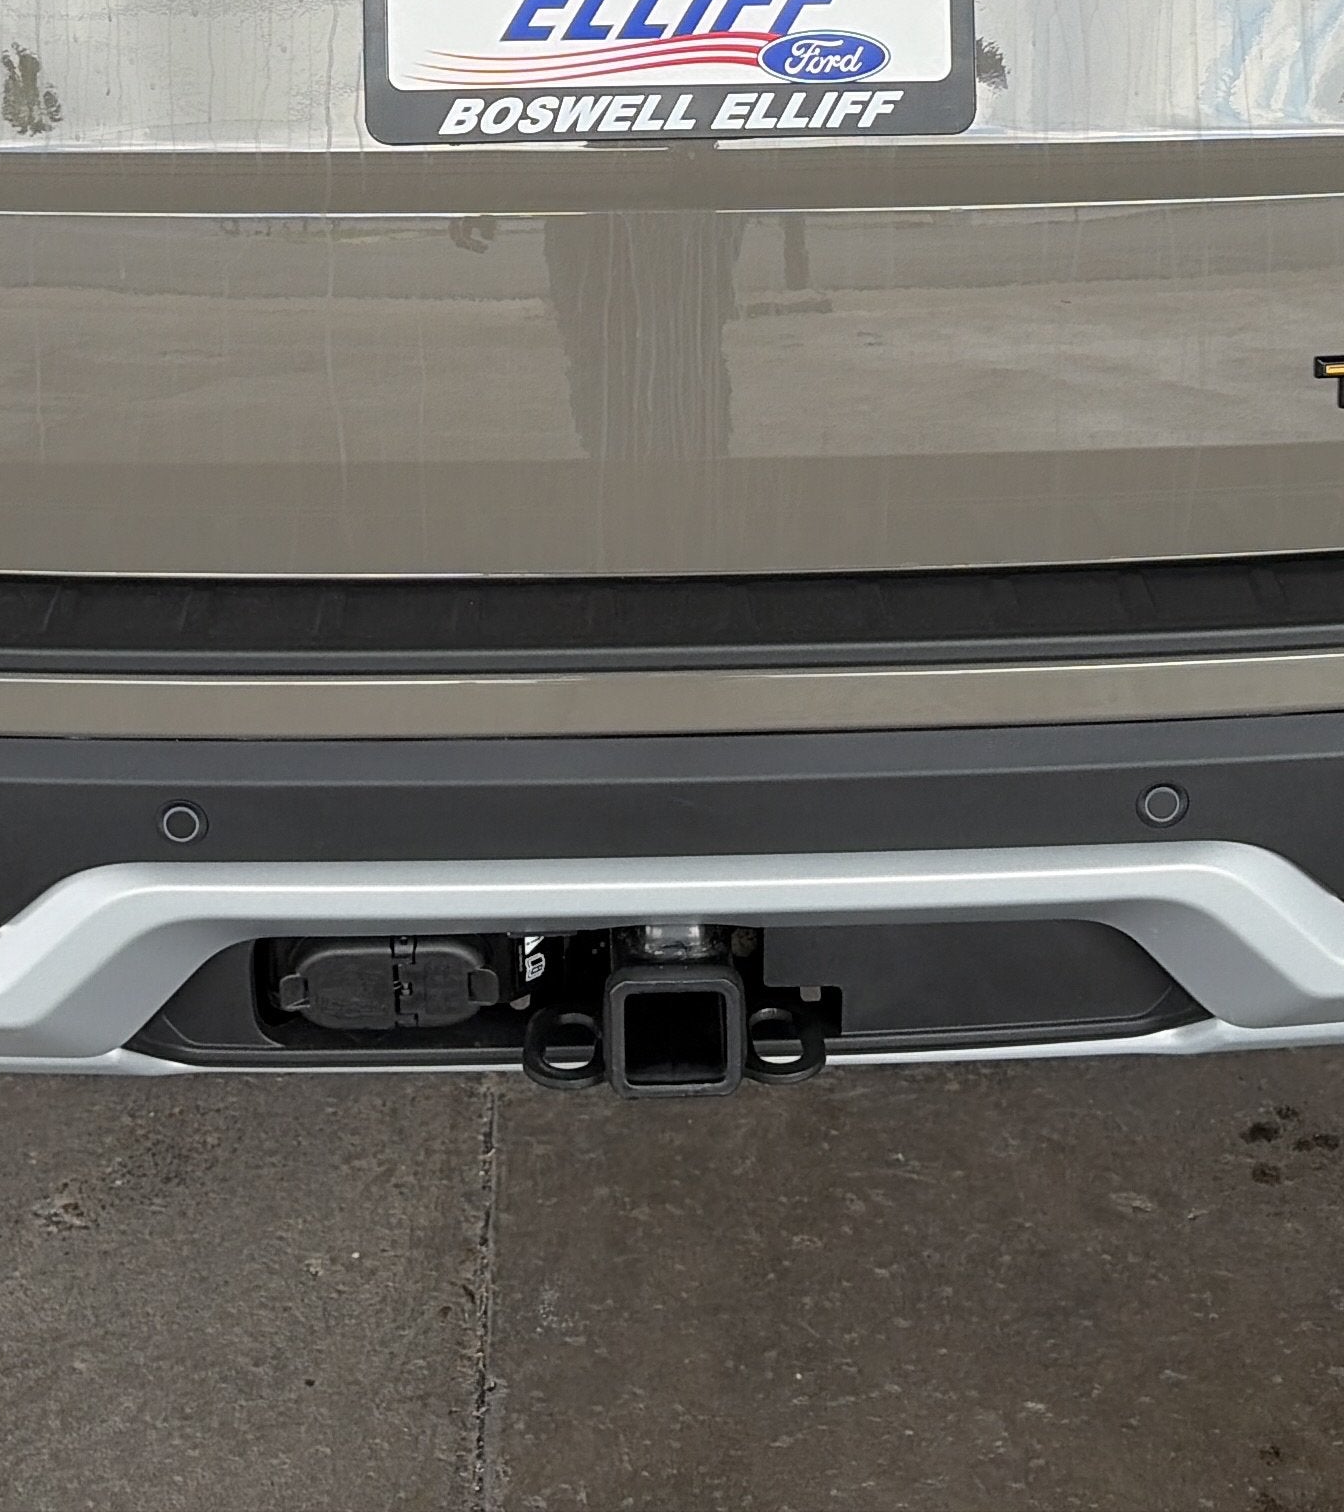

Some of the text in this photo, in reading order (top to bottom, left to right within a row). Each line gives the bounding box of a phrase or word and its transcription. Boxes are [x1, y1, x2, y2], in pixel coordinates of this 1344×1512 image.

[783, 38, 865, 78] Ford
[438, 90, 905, 136] BOSWELL ELLIFF
